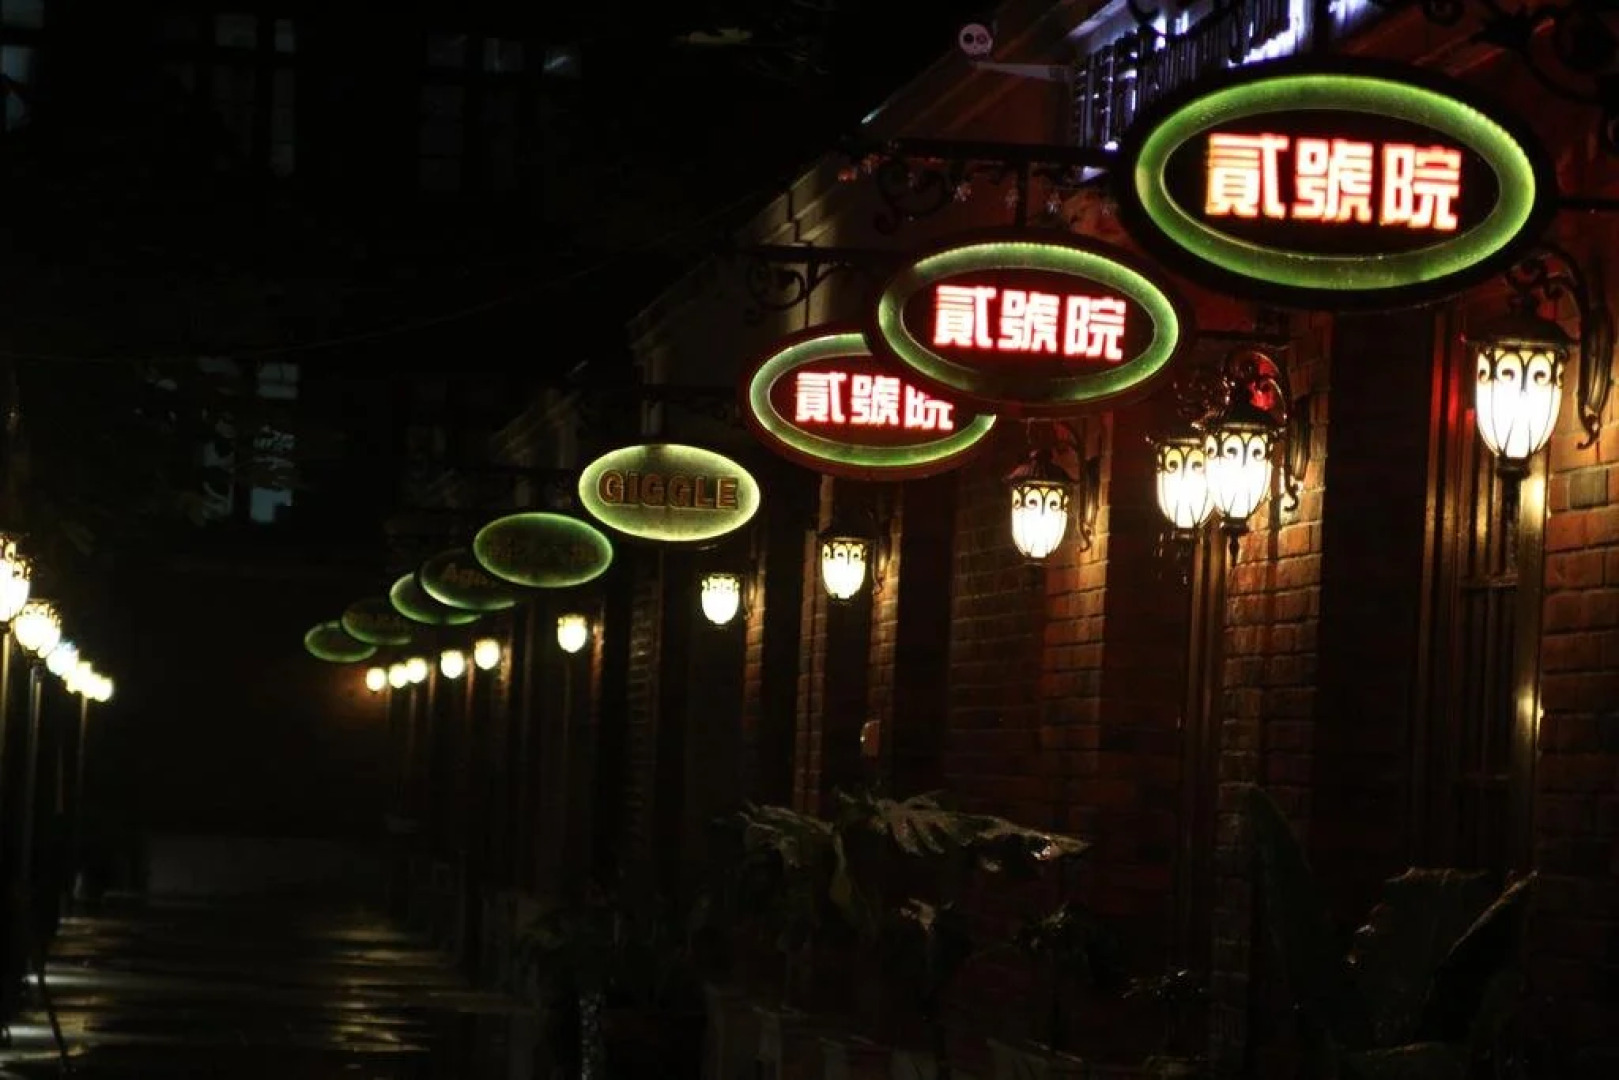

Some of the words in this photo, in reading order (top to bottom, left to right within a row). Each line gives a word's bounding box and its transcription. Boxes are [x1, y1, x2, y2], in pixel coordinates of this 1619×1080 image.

[1205, 132, 1462, 232] 貳號院
[932, 285, 1127, 361] 貳號院
[597, 468, 739, 510] GIGGLE
